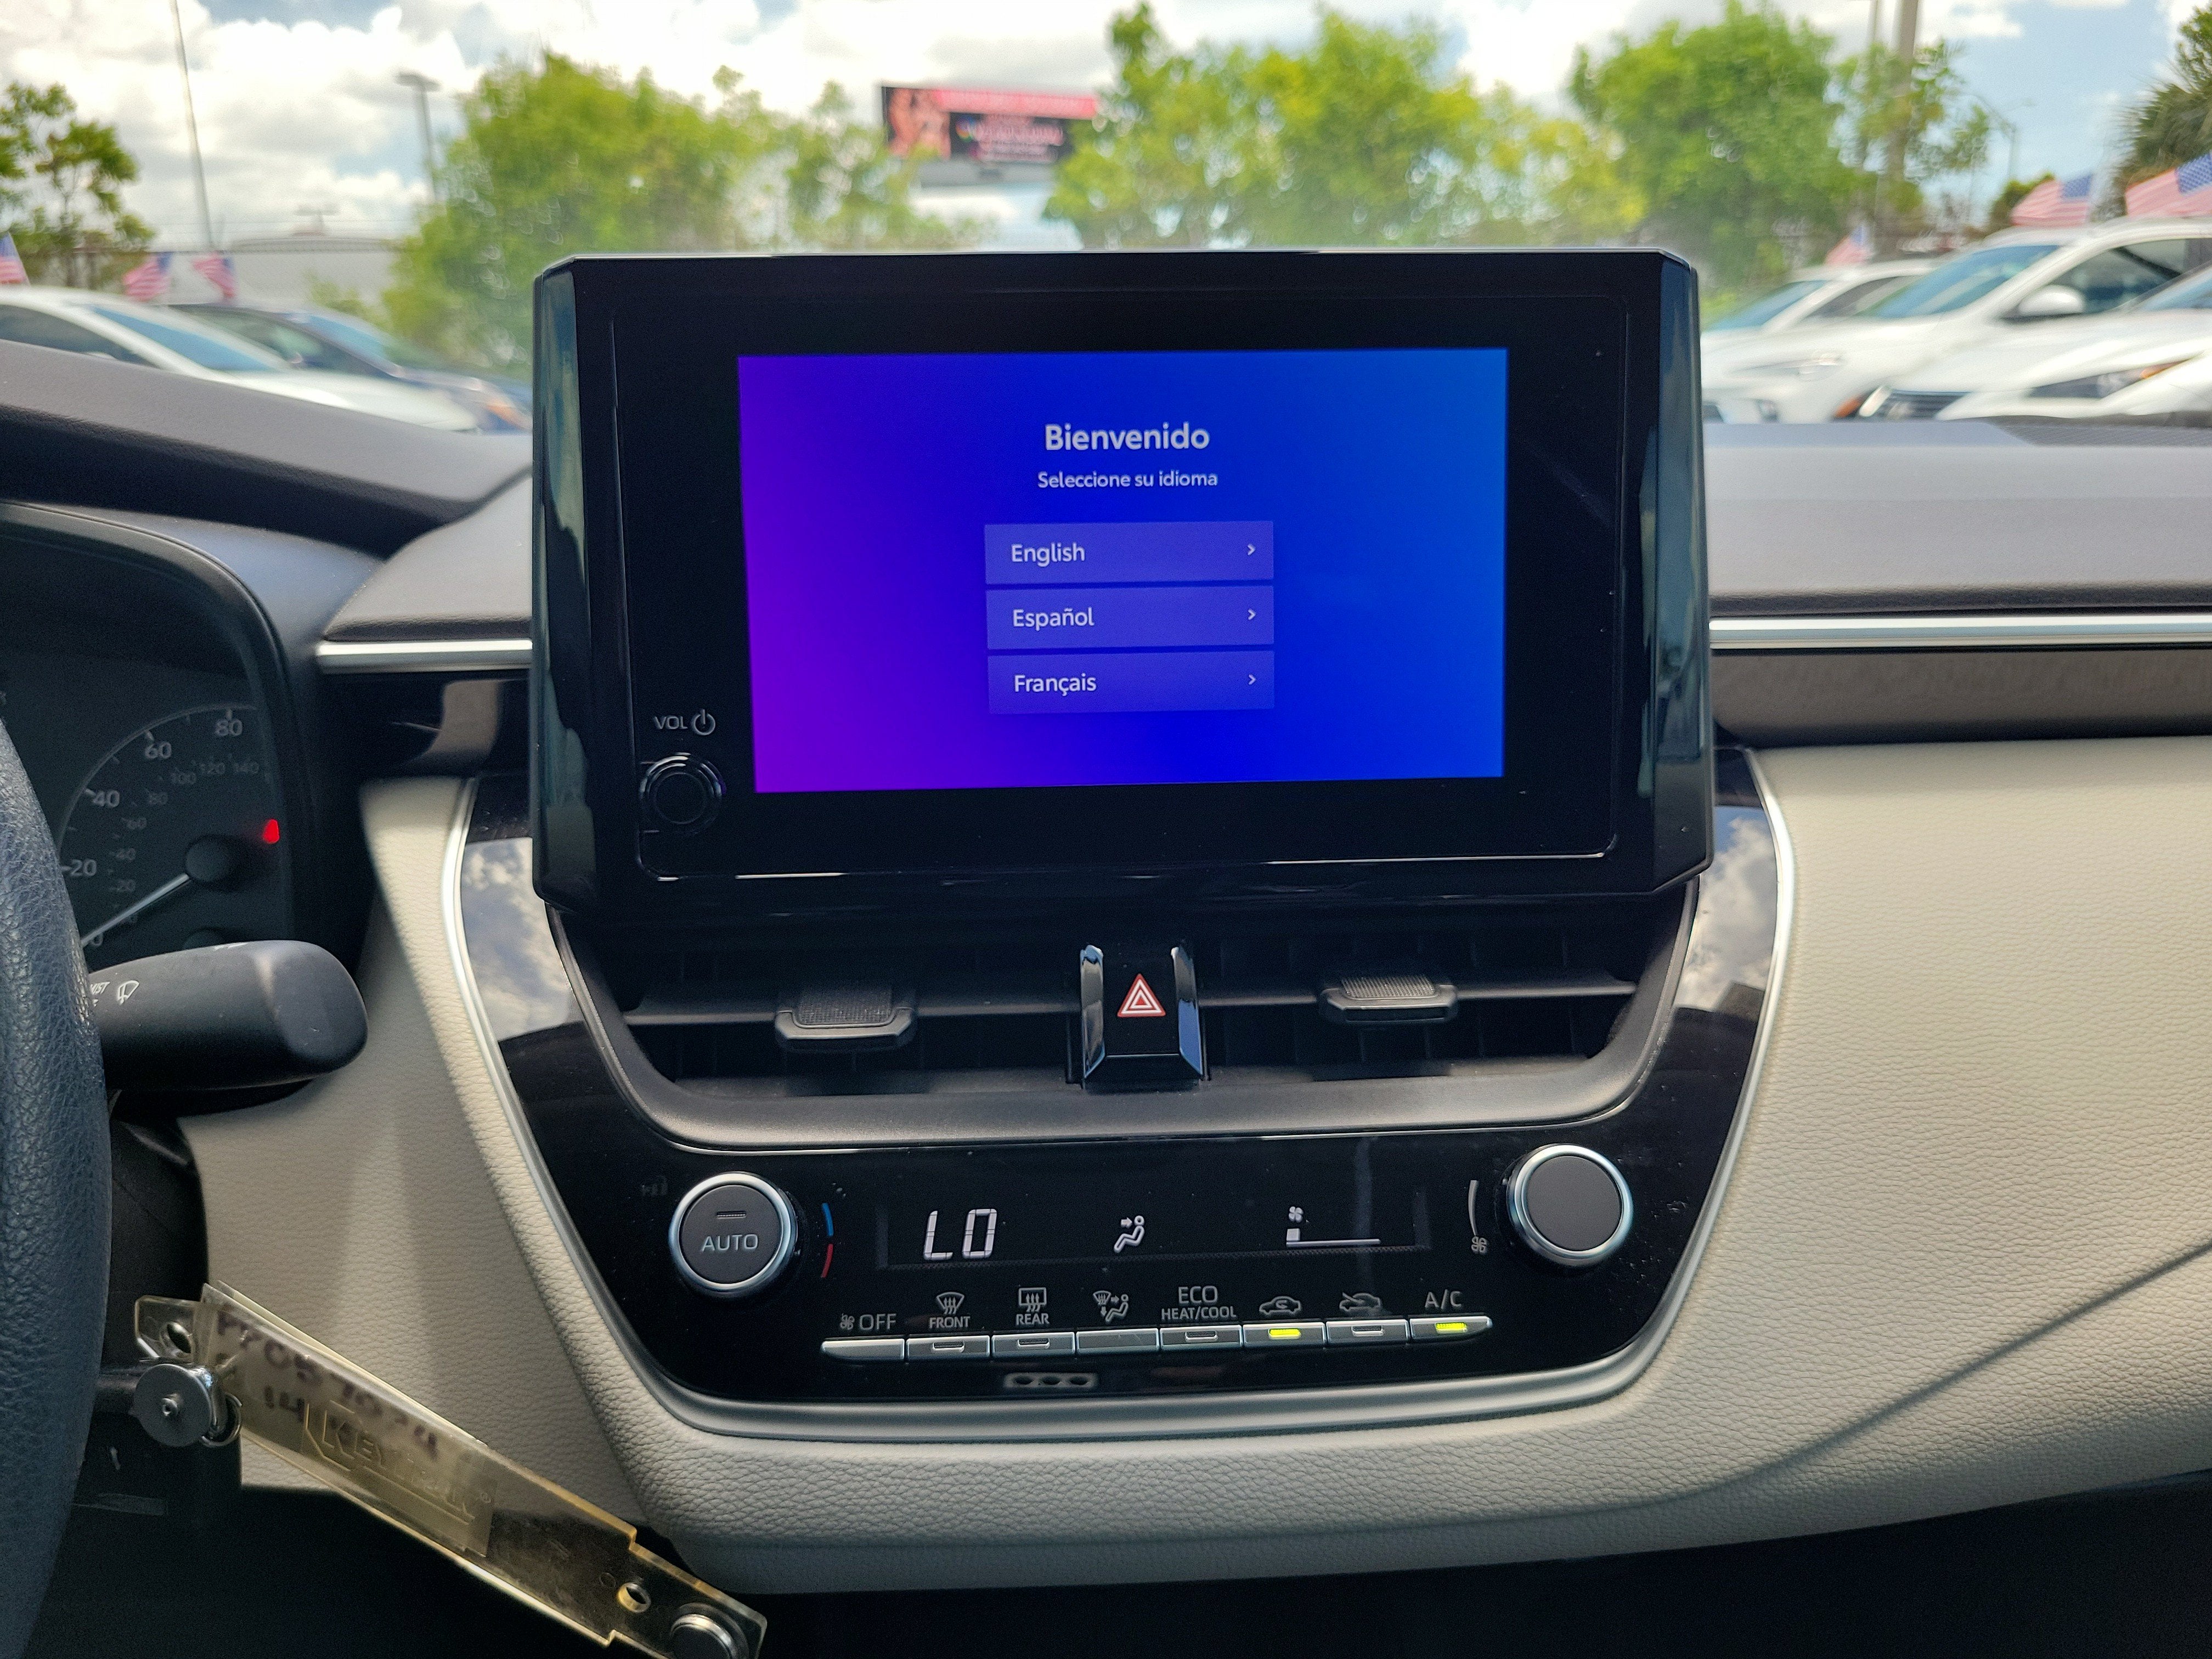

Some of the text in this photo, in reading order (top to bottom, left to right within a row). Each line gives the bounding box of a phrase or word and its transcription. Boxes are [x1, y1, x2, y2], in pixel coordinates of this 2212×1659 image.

[1044, 422, 1210, 451] Bienvenido
[1037, 470, 1218, 488] Seleccione su idioma
[1011, 542, 1086, 567] English
[1012, 607, 1095, 631] Español
[1014, 673, 1097, 696] Français
[215, 719, 243, 737] 80
[653, 715, 688, 730] VOL
[144, 741, 172, 759] 60
[92, 789, 120, 808] 40
[70, 859, 97, 877] 20
[702, 1233, 759, 1254] AUTO
[923, 1209, 998, 1261] LO
[1178, 1285, 1218, 1304] ECO
[1424, 1289, 1463, 1308] A/C
[859, 1313, 897, 1330] OFF
[929, 1315, 970, 1329] FRONT
[1015, 1312, 1050, 1326] REAR
[1161, 1305, 1237, 1321] HEAT/COOL
